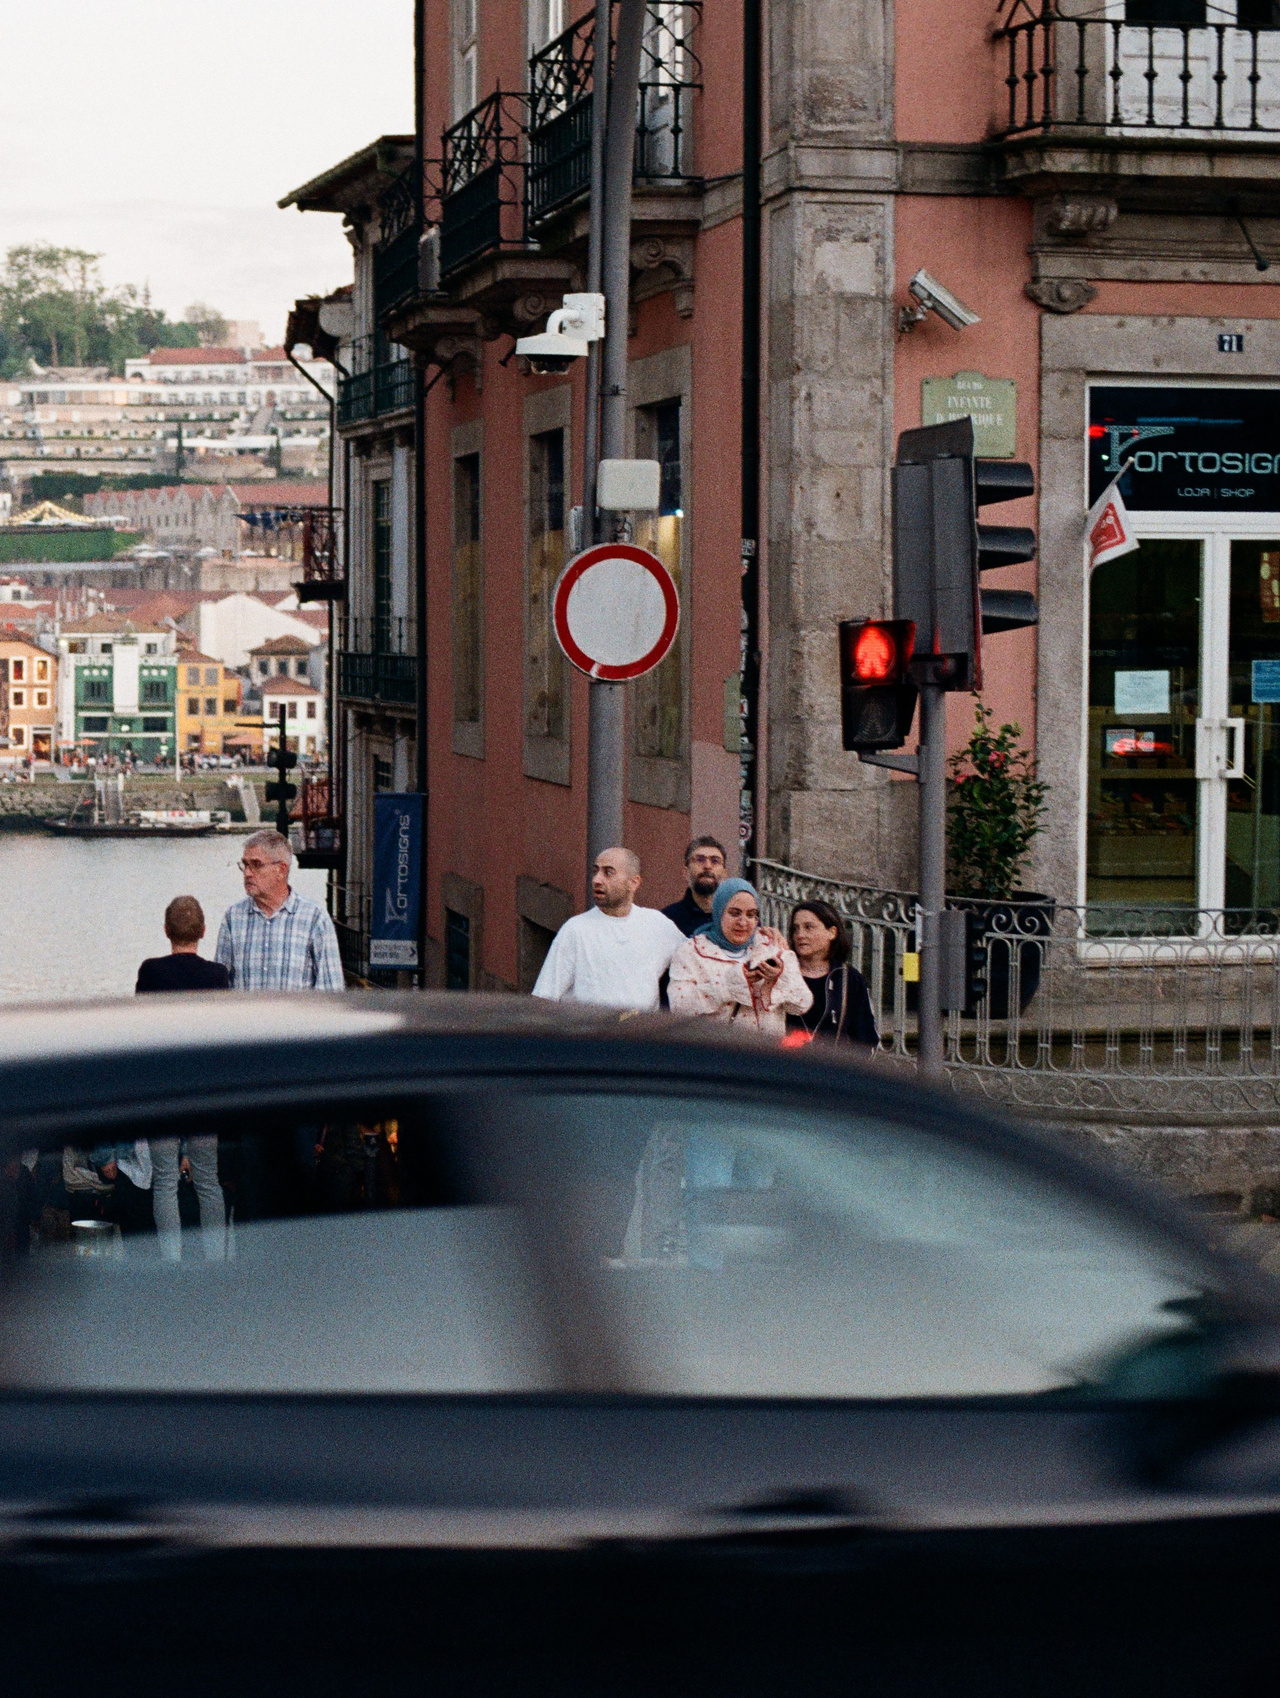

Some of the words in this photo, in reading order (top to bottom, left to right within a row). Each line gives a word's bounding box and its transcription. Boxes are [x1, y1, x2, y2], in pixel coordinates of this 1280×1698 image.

[1222, 335, 1238, 352] 71
[947, 396, 991, 409] INFANTE
[1177, 487, 1211, 497] LOJA
[1221, 488, 1255, 498] SHOP
